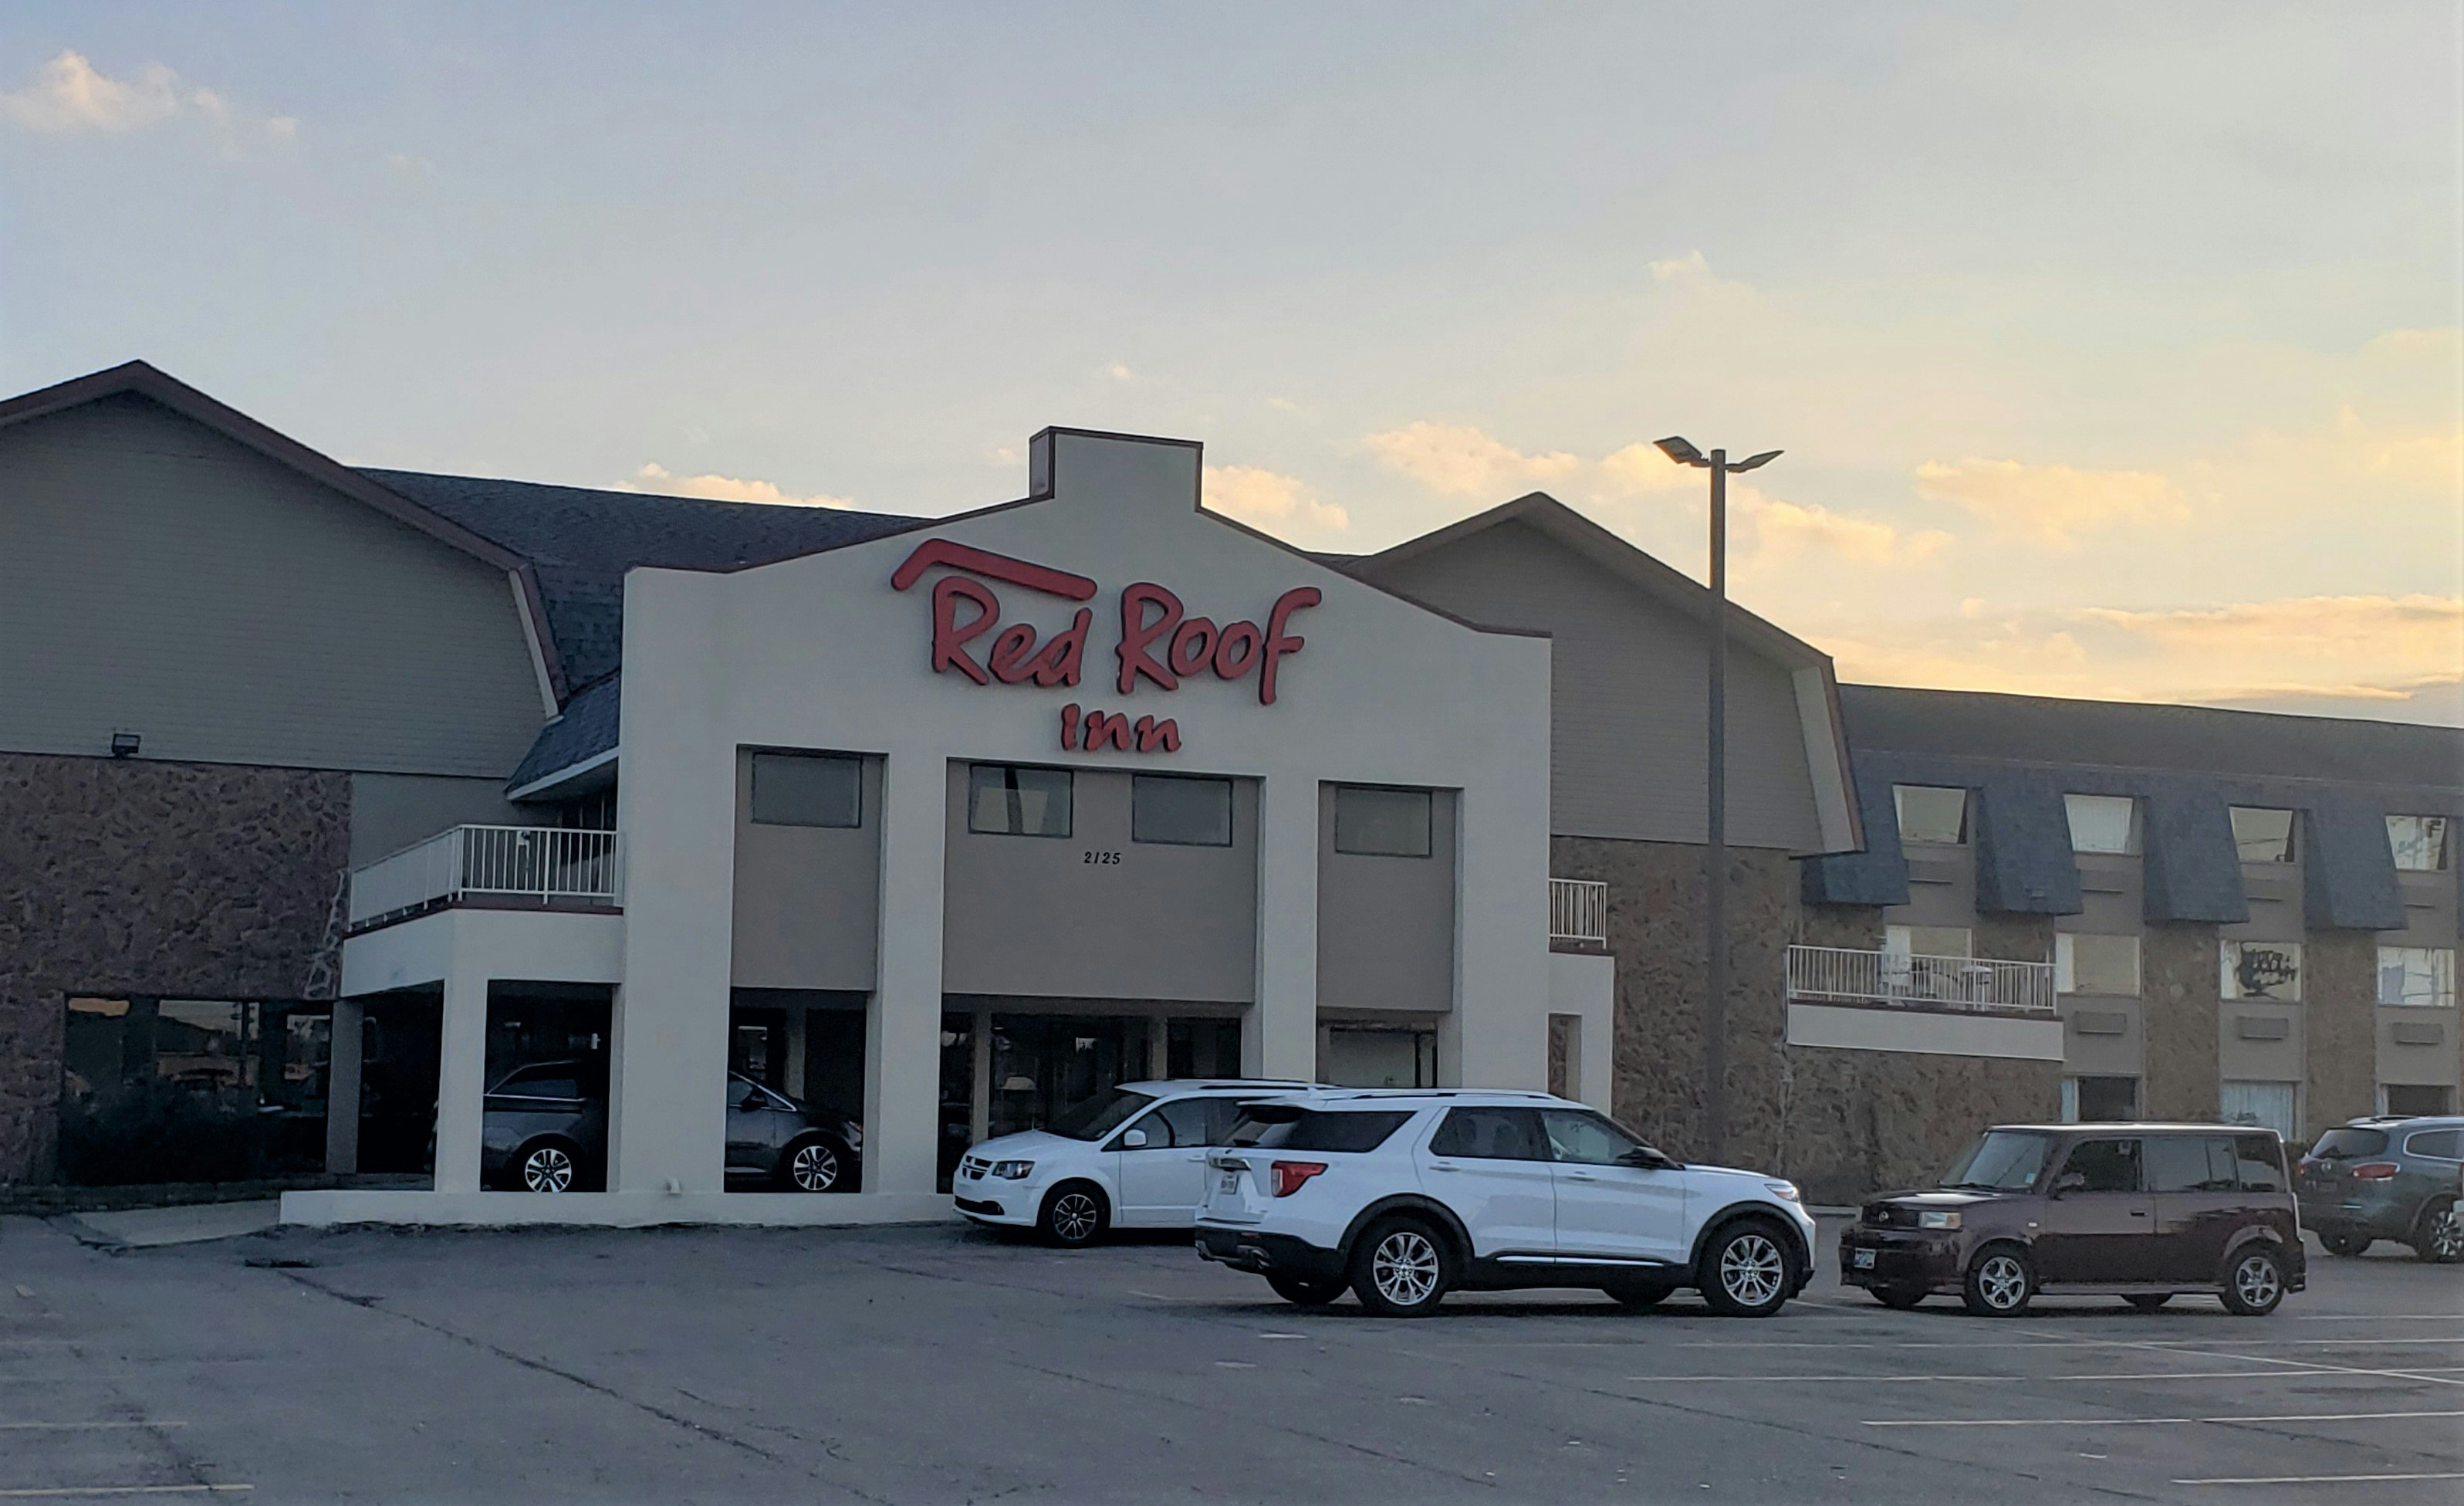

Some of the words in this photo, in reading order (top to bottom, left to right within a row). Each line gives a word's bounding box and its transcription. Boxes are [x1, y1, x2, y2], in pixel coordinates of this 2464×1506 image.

[932, 576, 1092, 686] Red
[1116, 582, 1322, 705] Roof
[1084, 851, 1121, 865] 2125
